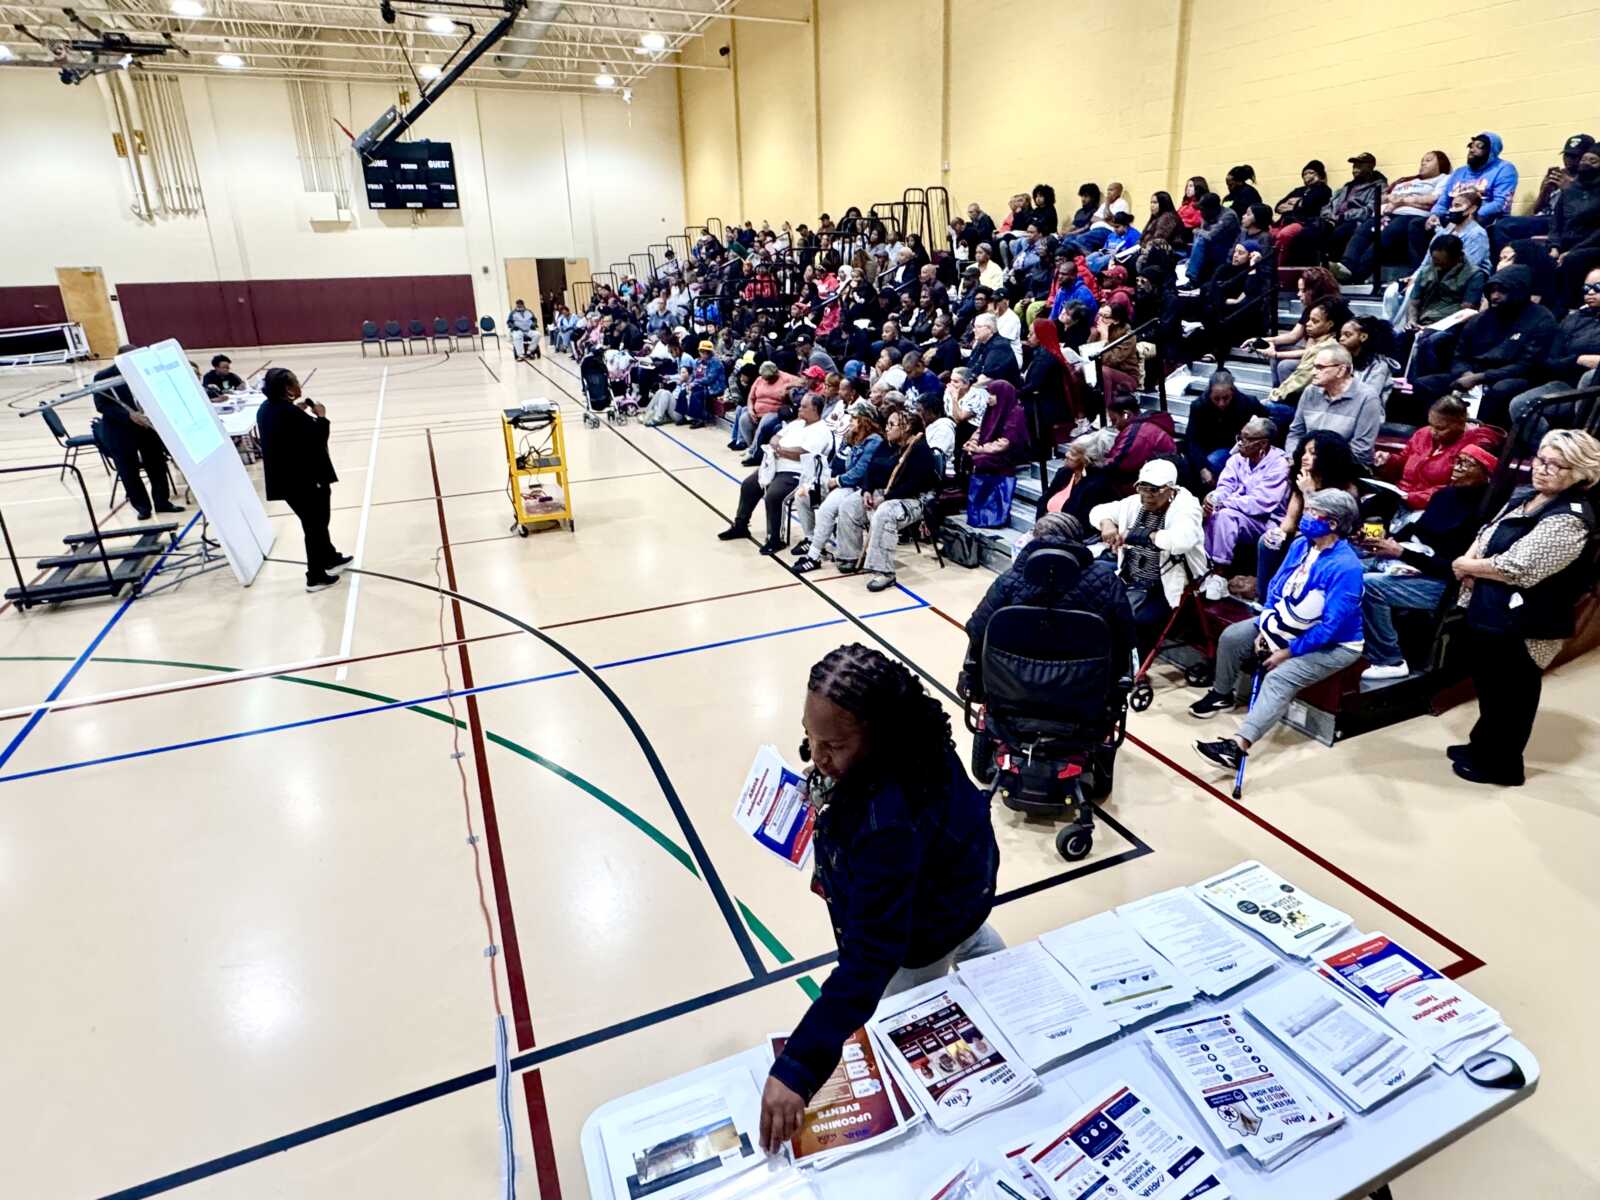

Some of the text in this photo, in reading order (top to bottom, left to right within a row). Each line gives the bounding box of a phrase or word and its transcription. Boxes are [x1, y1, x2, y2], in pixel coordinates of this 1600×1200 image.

[428, 160, 449, 168] GUEST
[943, 1094, 963, 1107] ARA
[1269, 1097, 1296, 1109] PREVENT
[816, 1102, 860, 1119] EVENTS
[811, 1111, 872, 1133] UPCOMING
